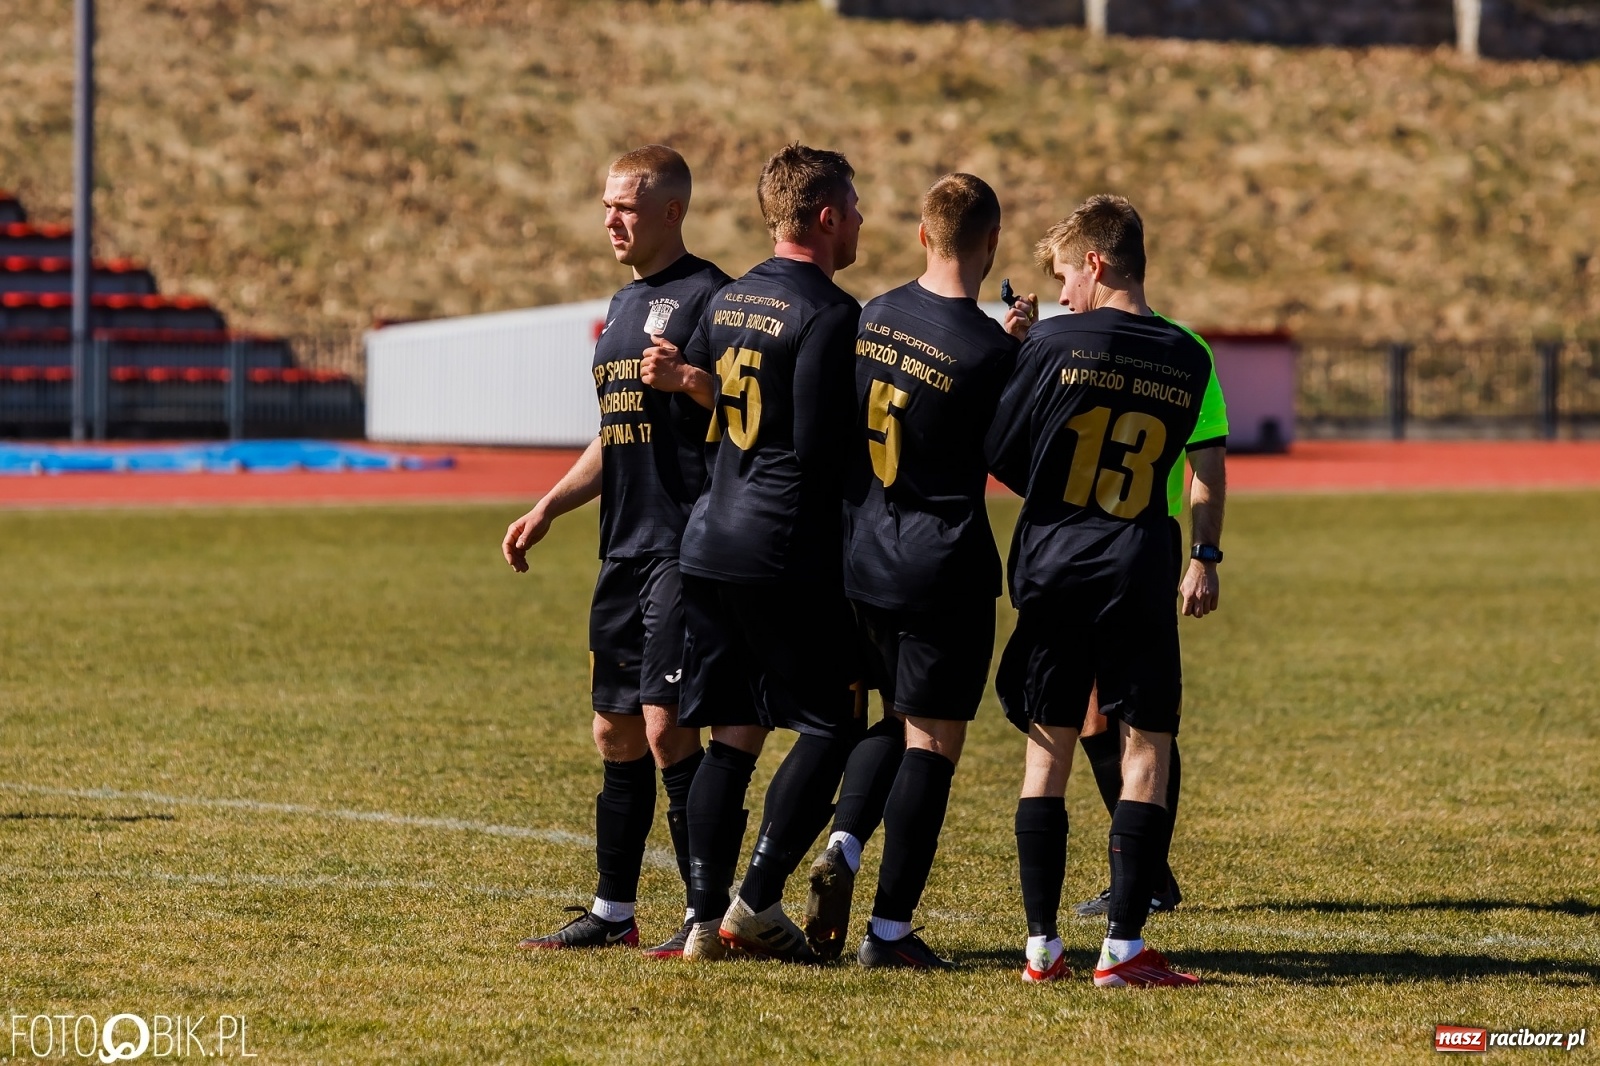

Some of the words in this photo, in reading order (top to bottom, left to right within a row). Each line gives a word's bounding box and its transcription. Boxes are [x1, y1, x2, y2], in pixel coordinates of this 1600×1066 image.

[724, 292, 743, 302] KLUB
[744, 294, 790, 311] SPORTOWY
[713, 307, 745, 328] NAPRZÓD
[745, 313, 784, 338] BORUCIN
[865, 321, 891, 336] KLUB
[892, 330, 957, 365] SPORTOWY
[606, 358, 642, 382] SPORT
[855, 338, 898, 366] NAPRZÓD
[901, 354, 954, 393] BORUCIN
[1072, 349, 1110, 362] KLUB
[1115, 355, 1191, 381] SPORTOWY
[705, 346, 762, 451] 15
[1061, 368, 1125, 390] NAPRZÓD
[1132, 378, 1192, 409] BORUCIN
[637, 423, 652, 443] 17
[868, 378, 910, 488] 5
[1063, 406, 1167, 519] 13
